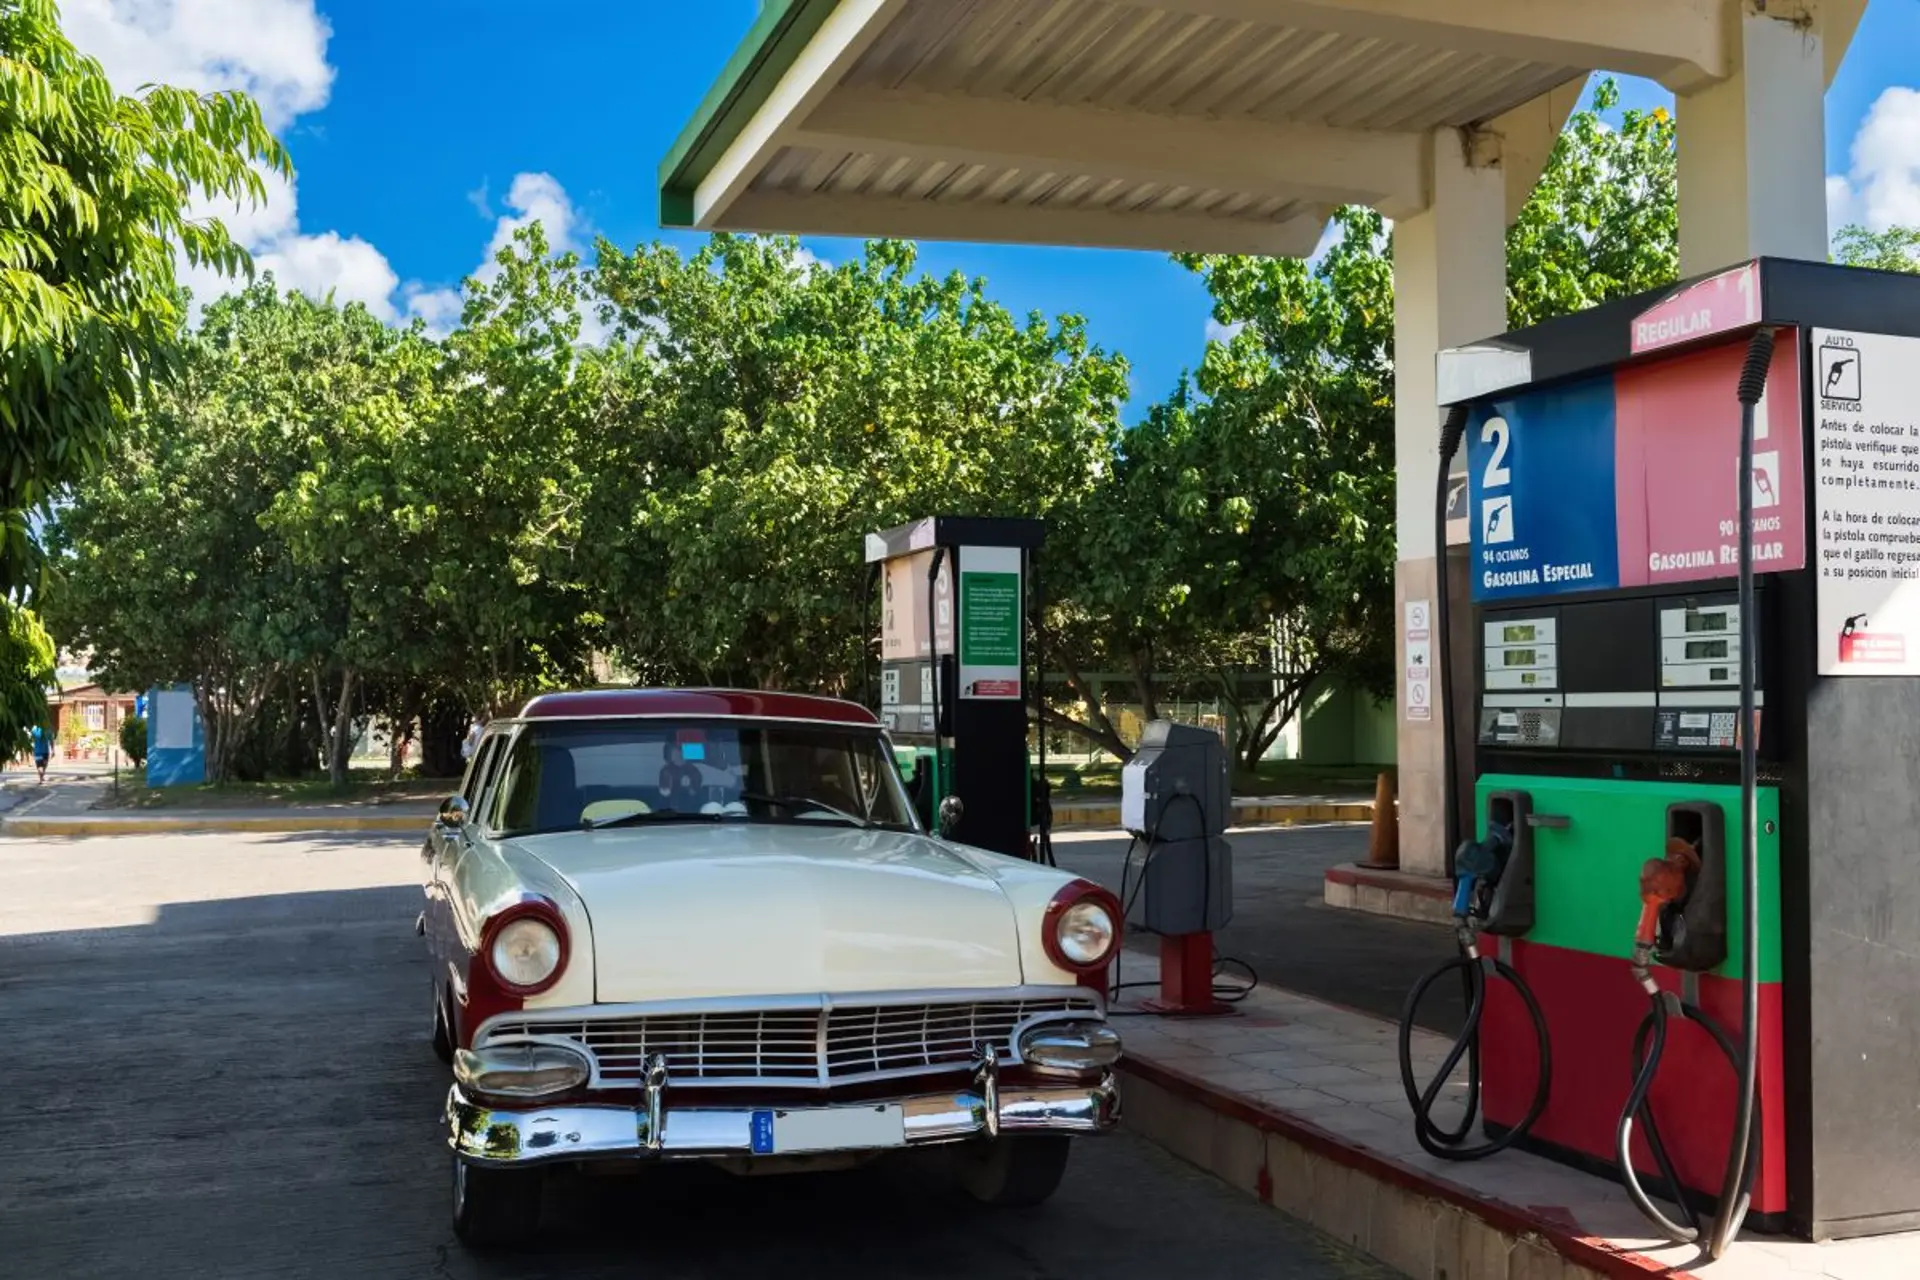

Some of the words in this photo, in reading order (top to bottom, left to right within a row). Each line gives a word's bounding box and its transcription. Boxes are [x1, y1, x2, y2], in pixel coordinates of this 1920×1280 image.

[1737, 265, 1755, 320] 1
[1636, 309, 1712, 346] REGULAR
[1825, 335, 1854, 347] AUTO
[1820, 400, 1862, 412] SERVICIO
[1820, 419, 1847, 432] Antes
[1852, 421, 1865, 433] de
[1869, 423, 1905, 436] colocar
[1909, 425, 1919, 437] la
[1481, 416, 1511, 489] 2
[1820, 437, 1852, 451] pistola
[1855, 440, 1897, 456] verifique
[1900, 446, 1919, 457] que
[1821, 458, 1832, 468] se
[1840, 456, 1864, 472] haya
[1872, 460, 1919, 473] escurrido
[1822, 510, 1830, 522] A
[1833, 510, 1842, 522] la
[1845, 511, 1868, 524] hora
[1871, 512, 1884, 524] de
[1719, 519, 1735, 537] 90
[1823, 528, 1831, 540] la
[1834, 529, 1866, 543] pistola
[1482, 550, 1496, 564] 94
[1495, 548, 1529, 563] OCTANOS
[1649, 549, 1716, 572] GASOLINA
[1823, 550, 1841, 561] que
[1842, 548, 1852, 560] el
[1854, 548, 1884, 563] gatillo
[1483, 568, 1540, 588] GASOLINA
[1542, 562, 1594, 582] ESPECIAL
[1823, 568, 1830, 577] a
[1833, 568, 1845, 578] su
